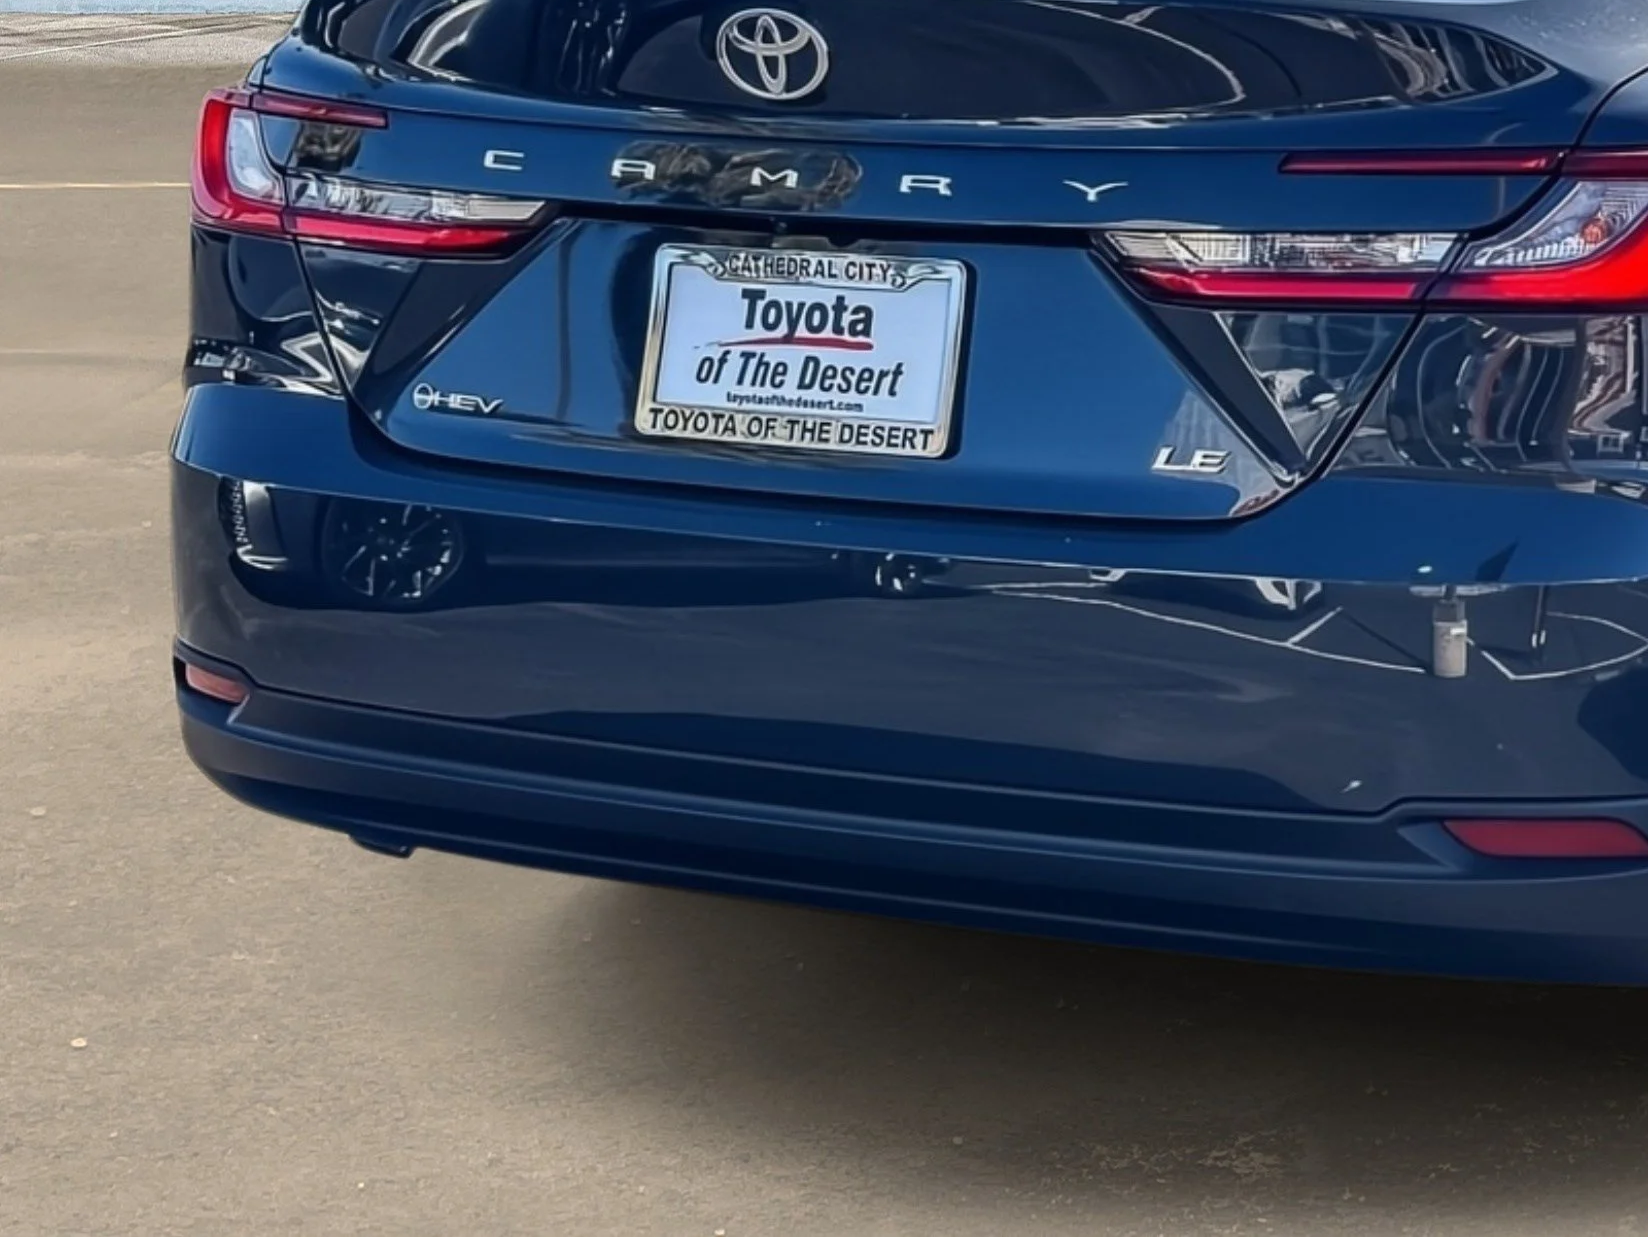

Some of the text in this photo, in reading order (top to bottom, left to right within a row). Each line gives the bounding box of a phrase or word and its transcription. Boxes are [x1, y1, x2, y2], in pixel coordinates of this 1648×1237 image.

[483, 149, 1129, 202] CAMRY
[727, 254, 893, 283] CATHEDRAL CITY
[741, 288, 874, 342] Toyota
[696, 350, 904, 398] of The Desert
[726, 390, 864, 413] toyotaofthedesert.com
[649, 407, 935, 451] TOYOTA OF THE DESERT
[1151, 446, 1229, 474] LE
